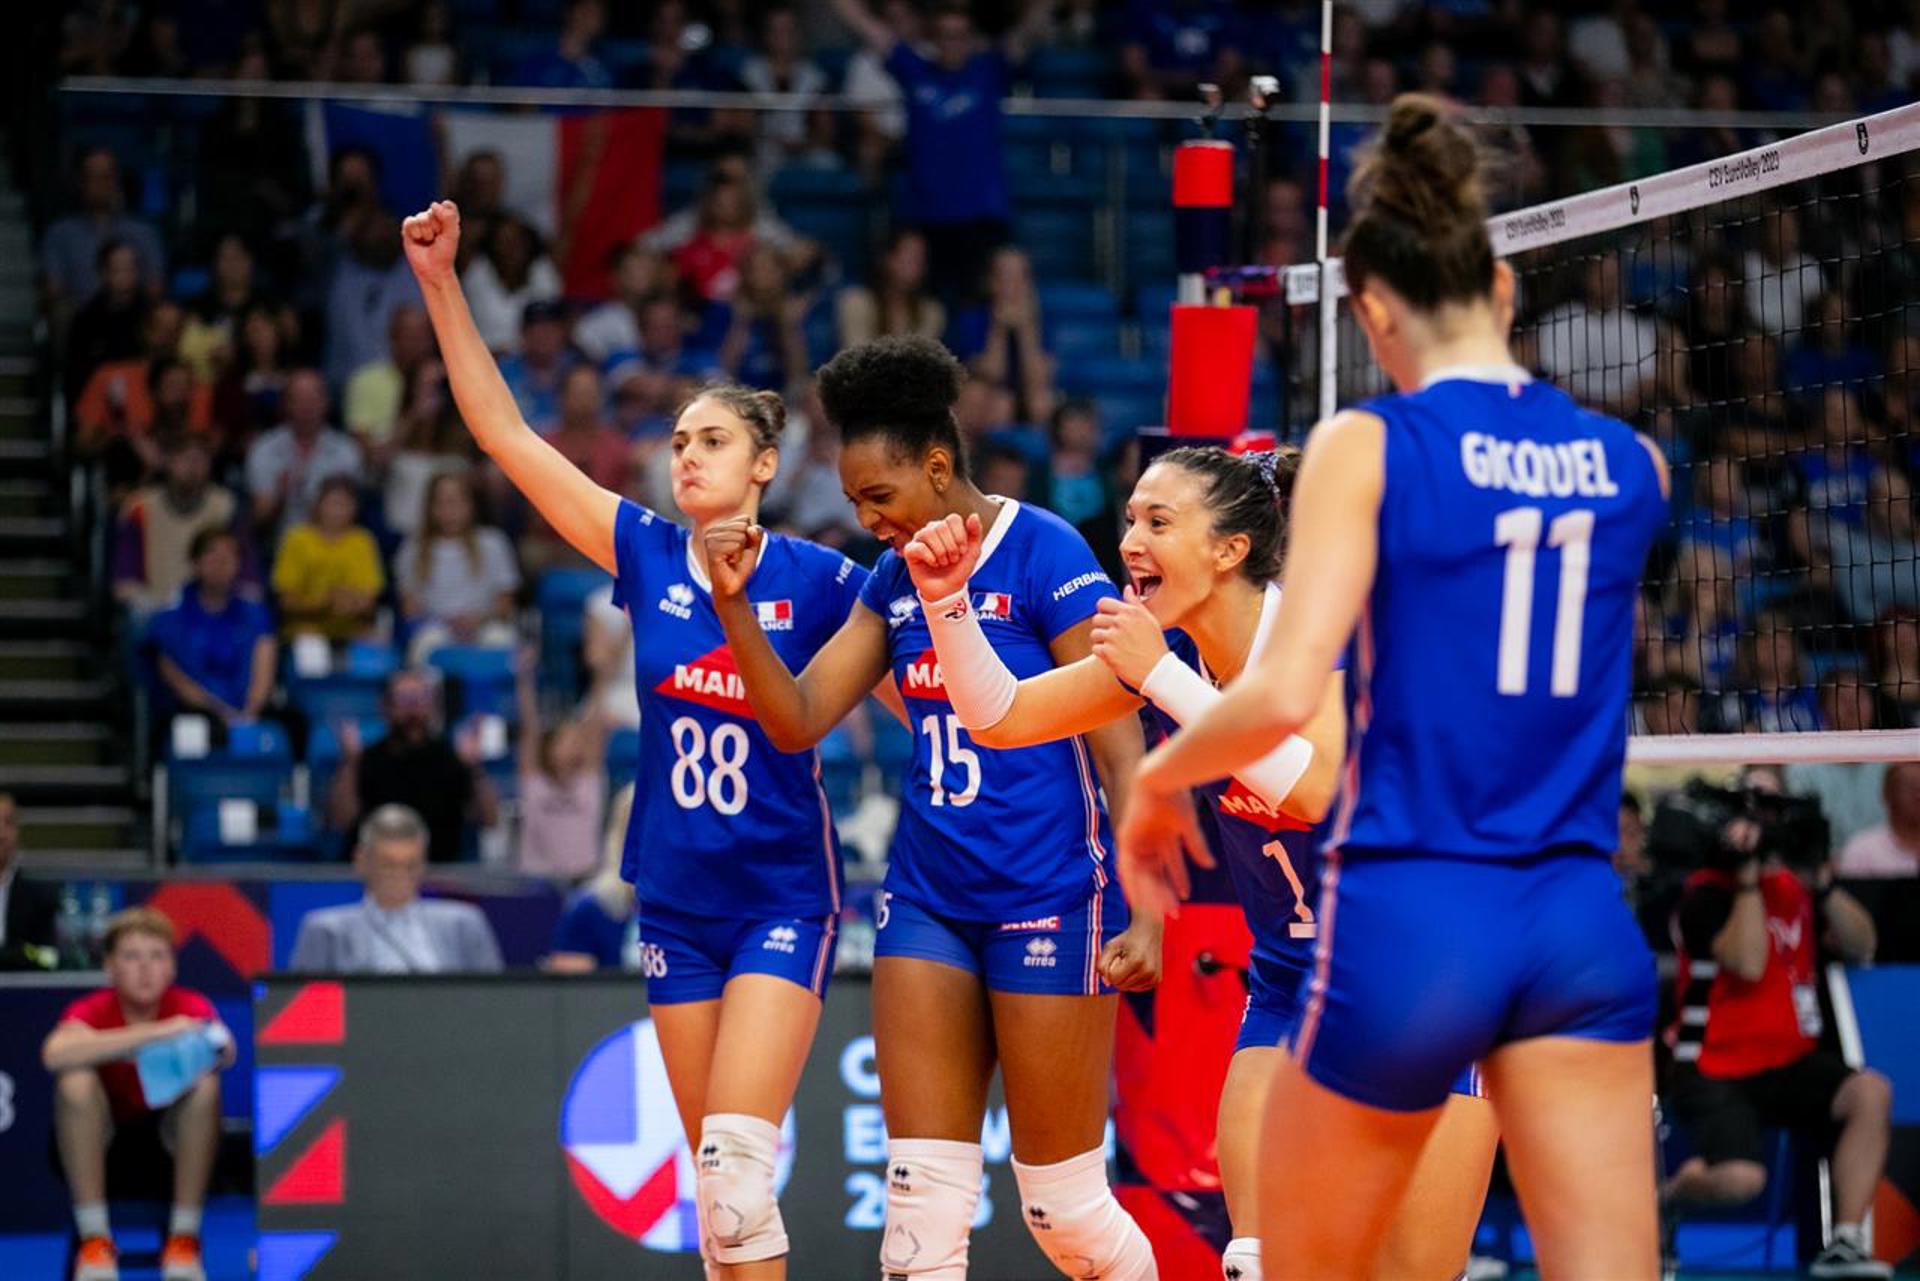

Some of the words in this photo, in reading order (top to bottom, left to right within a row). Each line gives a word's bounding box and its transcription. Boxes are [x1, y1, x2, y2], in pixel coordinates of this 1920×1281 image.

[1460, 431, 1619, 498] GICQUEL
[1494, 506, 1596, 697] 11
[671, 716, 749, 815] 88
[922, 714, 981, 807] 15
[1262, 840, 1318, 938] 1
